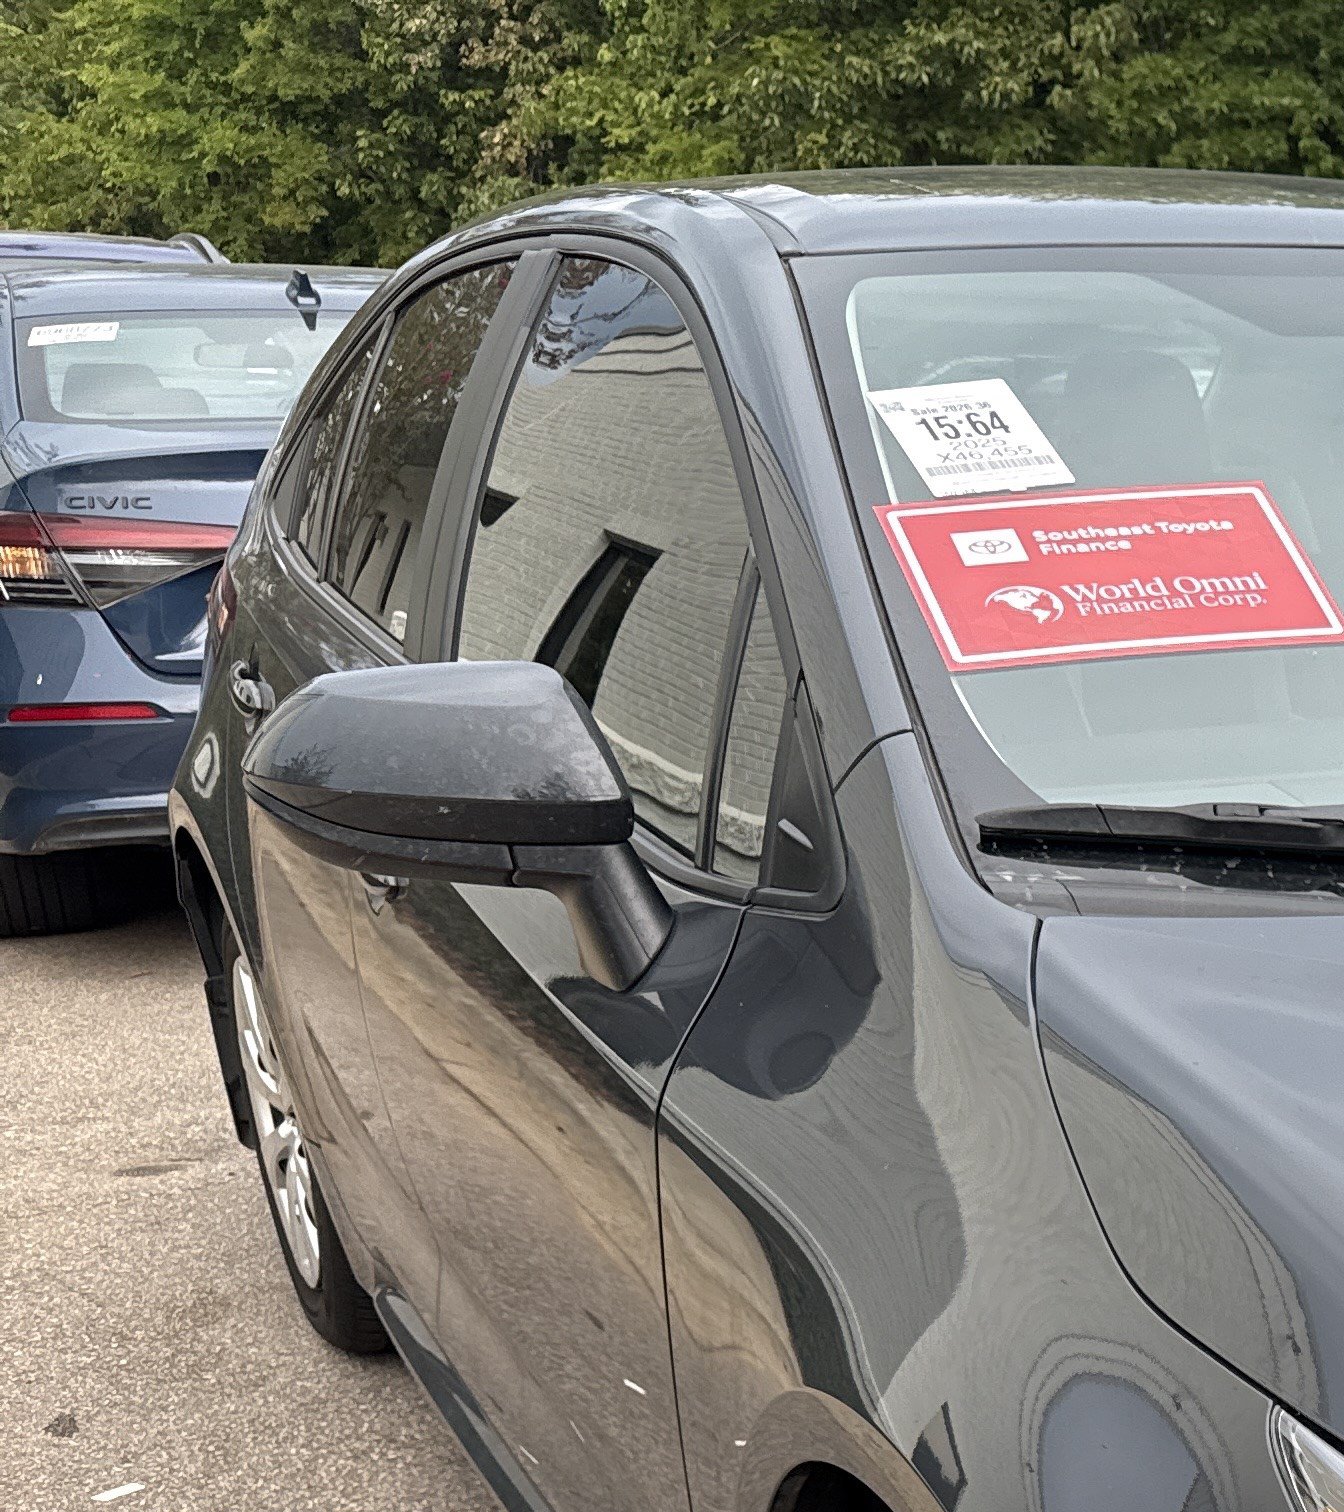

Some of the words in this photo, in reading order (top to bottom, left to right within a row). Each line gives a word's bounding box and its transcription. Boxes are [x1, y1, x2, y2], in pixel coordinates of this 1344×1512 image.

[914, 410, 1012, 442] 15:64
[949, 437, 1007, 451] 2025
[63, 496, 153, 510] CIVIC
[1032, 523, 1155, 543] Southeast
[1154, 519, 1235, 535] Toyota
[1038, 539, 1133, 556] Finance
[1059, 577, 1170, 603] World
[1173, 571, 1269, 595] Omni
[1076, 593, 1196, 617] Financial
[1200, 591, 1268, 608] Corp.
